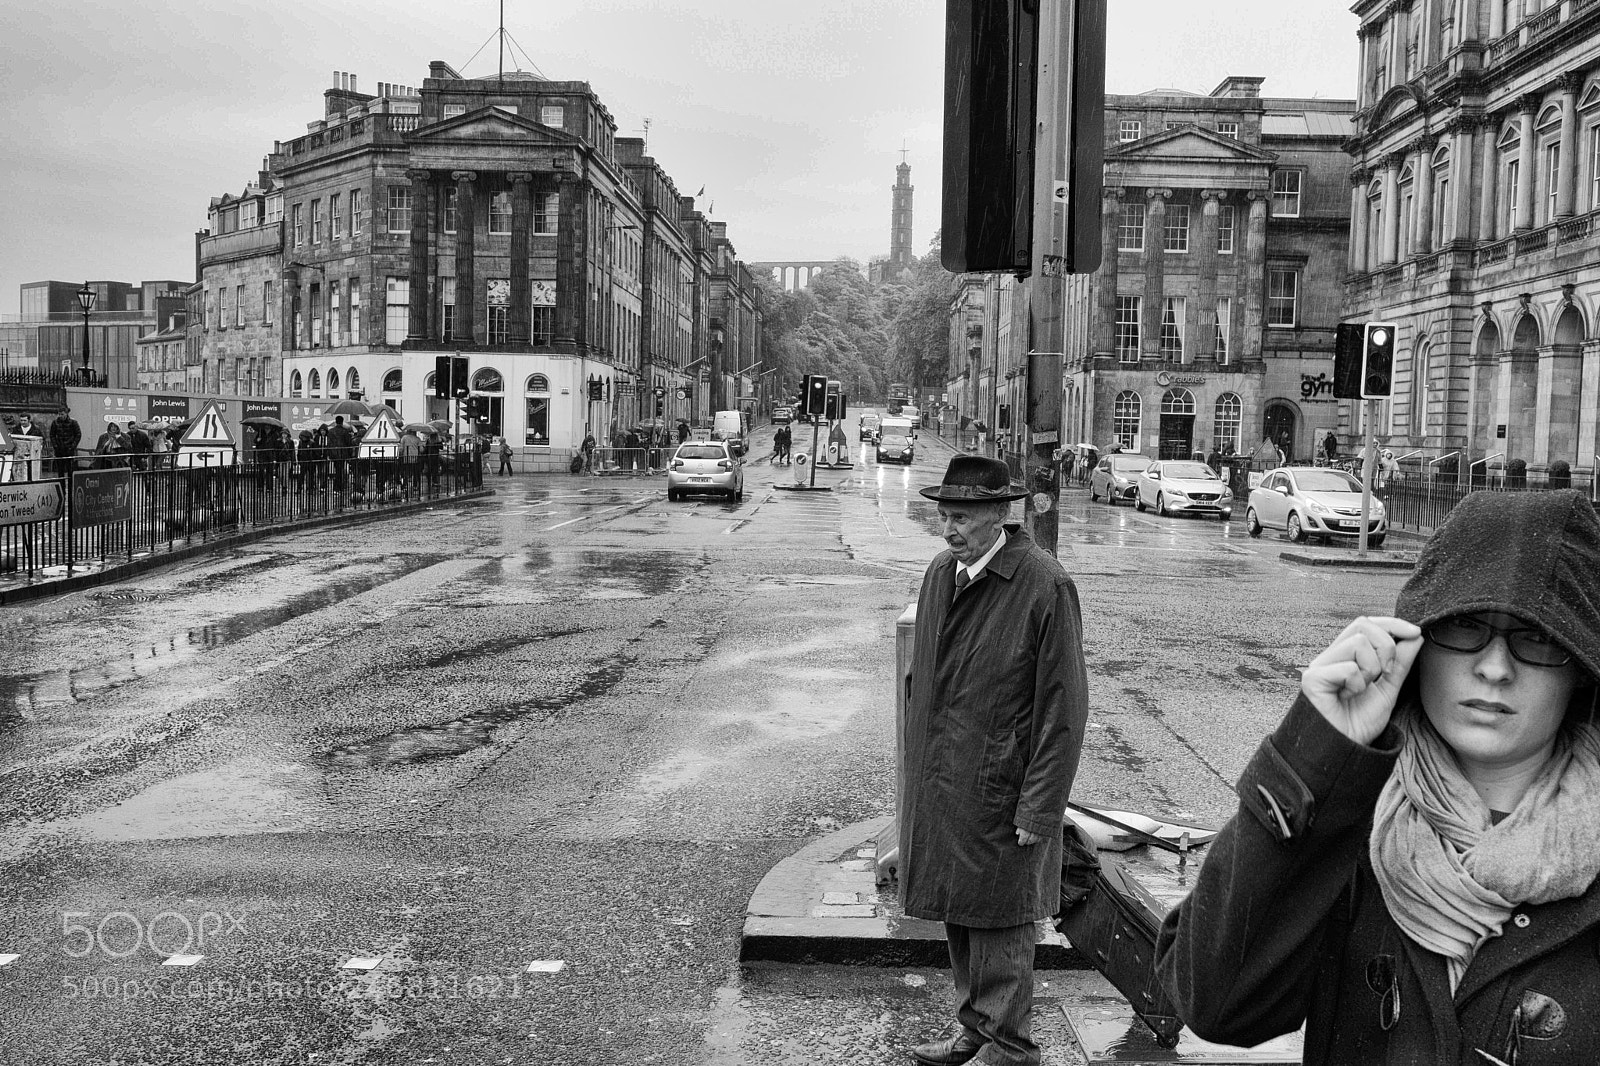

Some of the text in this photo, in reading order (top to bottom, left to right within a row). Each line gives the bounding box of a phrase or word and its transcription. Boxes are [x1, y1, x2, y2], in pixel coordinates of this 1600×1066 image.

[152, 399, 167, 407] John
[246, 404, 260, 412] John
[37, 494, 53, 509] (A1)
[11, 503, 35, 517] Tweed
